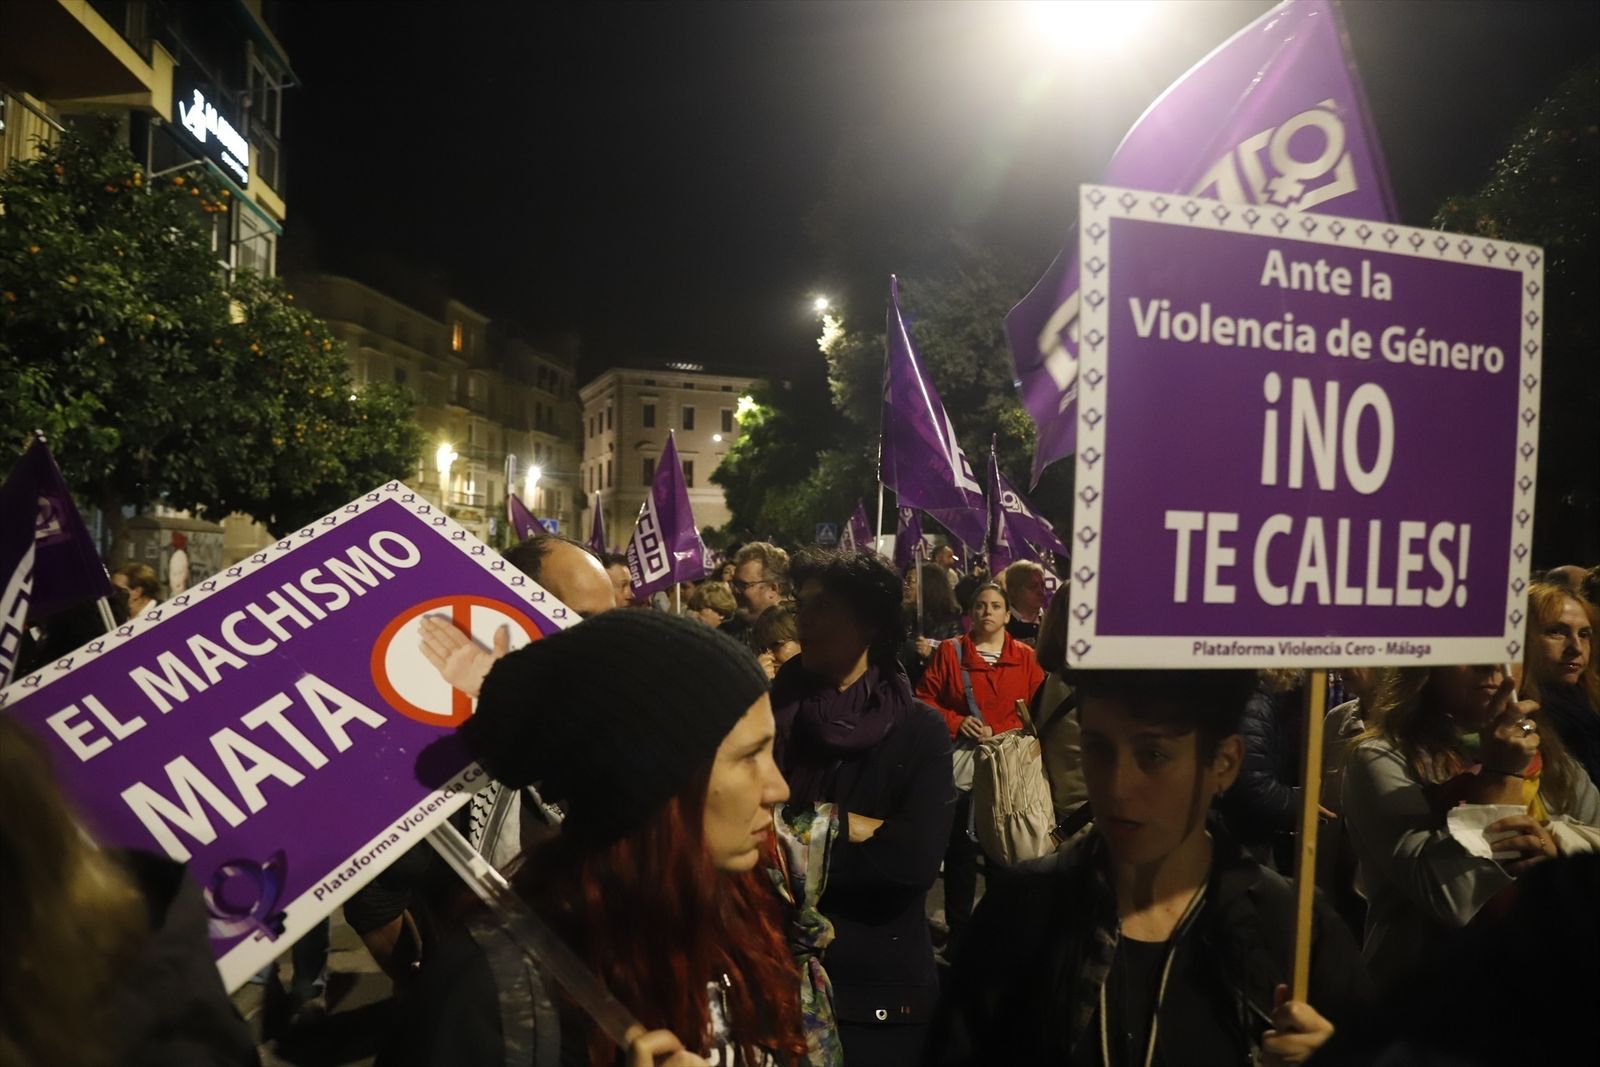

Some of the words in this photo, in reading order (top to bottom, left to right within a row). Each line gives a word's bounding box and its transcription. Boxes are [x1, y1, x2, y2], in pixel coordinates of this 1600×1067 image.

[1260, 249, 1352, 296] Ante
[1361, 260, 1393, 301] la
[1129, 297, 1316, 354] Violencia
[1326, 318, 1372, 360] de
[1380, 325, 1504, 374] Género
[1261, 371, 1395, 495] ¡NO
[1164, 510, 1239, 604] TE
[1253, 513, 1471, 608] CALLES!
[45, 694, 147, 762] EL
[128, 530, 421, 714] MACHISMO
[1193, 641, 1275, 656] Plataforma
[1278, 641, 1342, 656] Violencia
[1345, 642, 1375, 656] Cero
[1385, 640, 1431, 658] Málaga
[120, 672, 388, 864] MATA
[313, 832, 400, 901] Plataforma
[397, 782, 464, 833] Violencia
